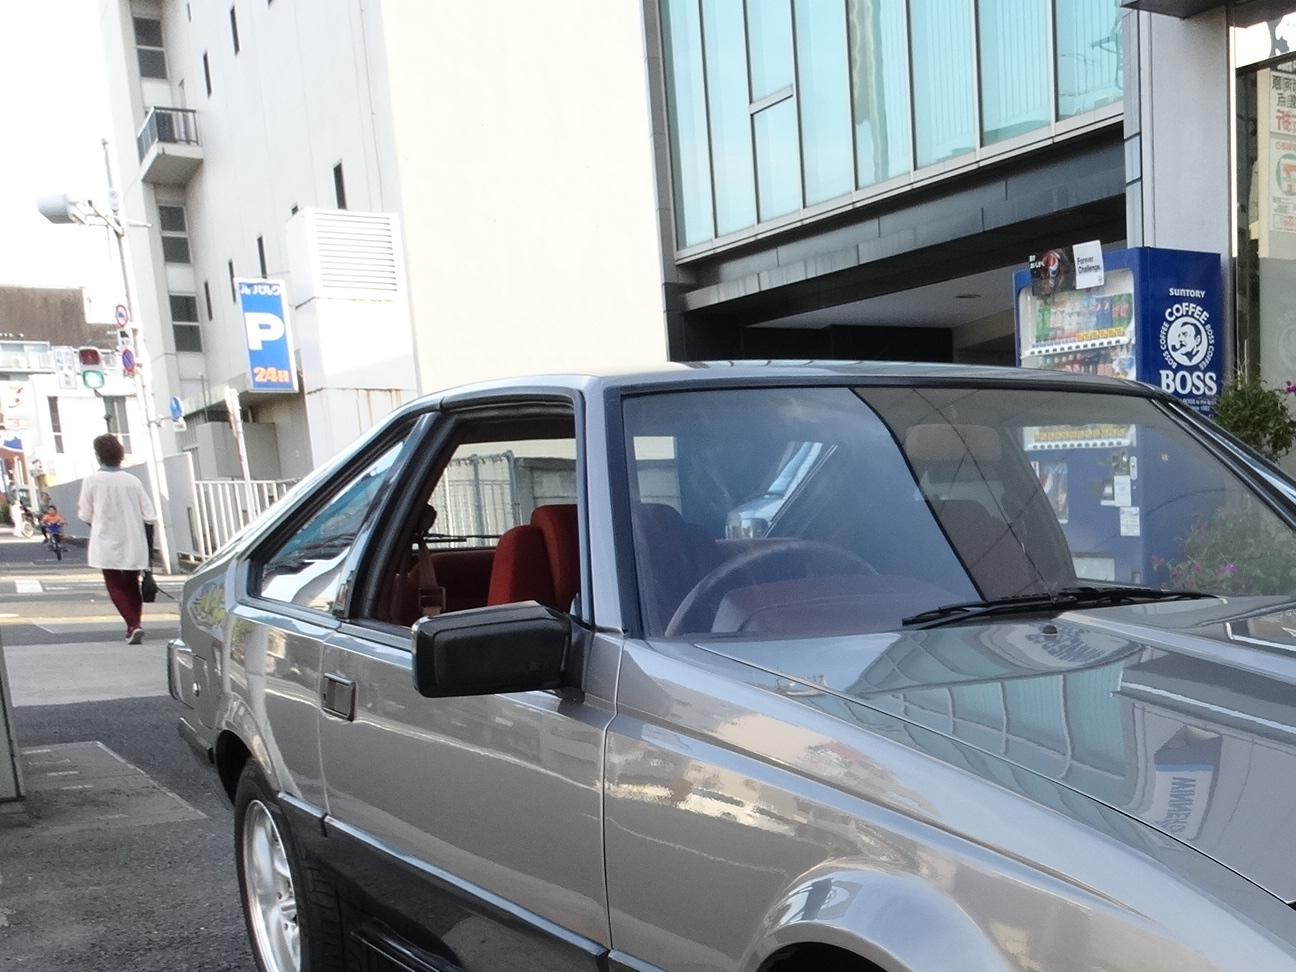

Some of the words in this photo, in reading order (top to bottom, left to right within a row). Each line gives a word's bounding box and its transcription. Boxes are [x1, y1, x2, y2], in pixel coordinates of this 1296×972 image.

[1165, 302, 1210, 324] COFFEE
[245, 312, 285, 350] P
[1159, 321, 1170, 350] COFFEE
[1204, 323, 1215, 344] BOSS
[1162, 351, 1178, 369] BOSS
[1199, 345, 1215, 370] COFFEE
[1159, 369, 1217, 396] BOSS
